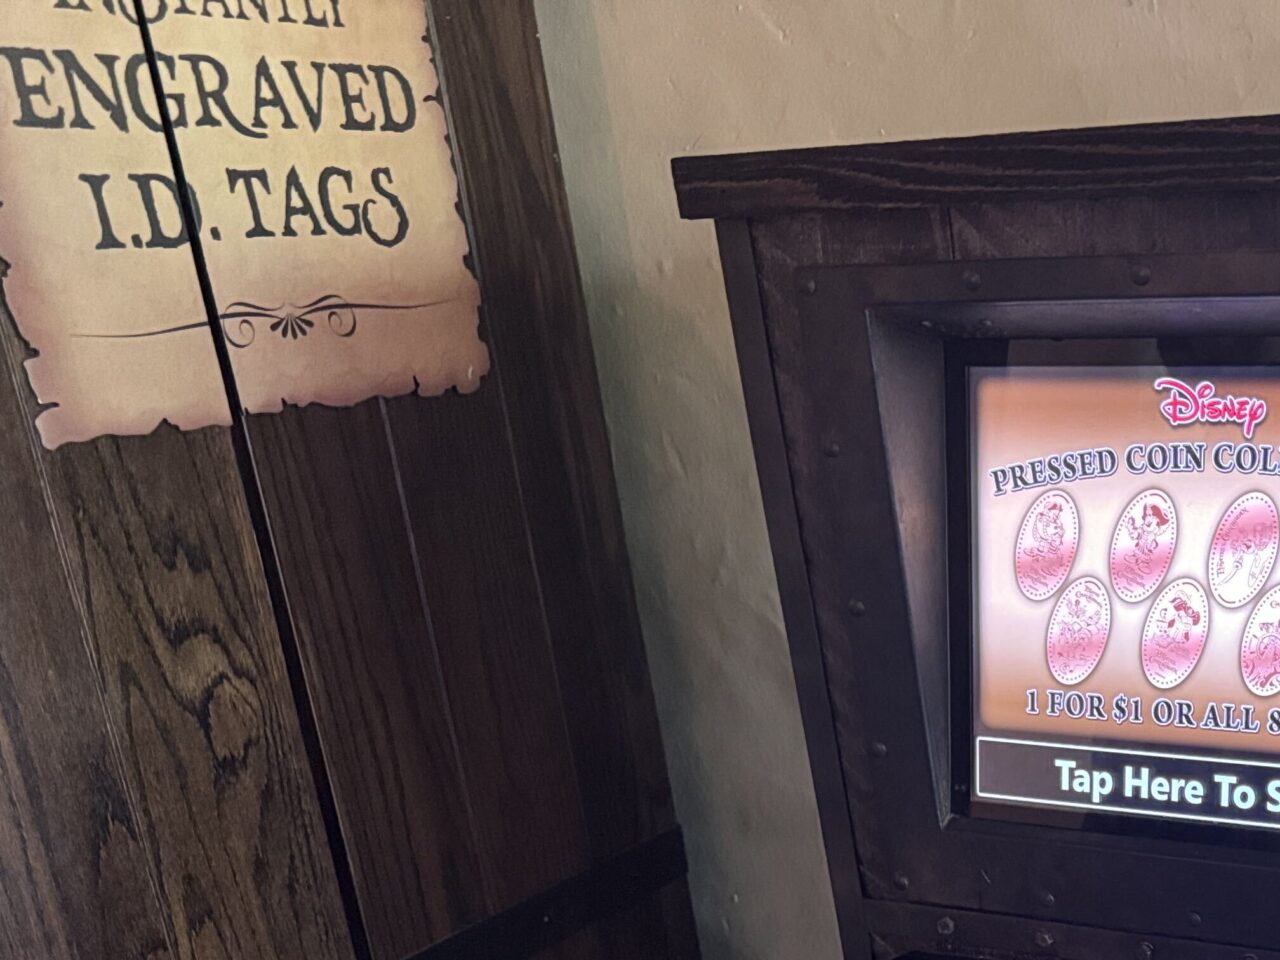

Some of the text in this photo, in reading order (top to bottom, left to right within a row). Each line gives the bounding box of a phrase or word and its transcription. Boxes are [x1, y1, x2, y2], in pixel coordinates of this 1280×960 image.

[0, 47, 417, 139] ENGRAVED
[78, 164, 410, 250] I.D. TAGS
[1153, 377, 1268, 439] Disney
[990, 448, 1118, 496] PRESSED
[1125, 442, 1206, 474] COIN
[1026, 689, 1039, 715] 1
[1047, 690, 1106, 721] FOR
[1112, 695, 1143, 724] $1
[1151, 698, 1197, 729] OR
[1201, 703, 1260, 734] ALL
[1054, 759, 1114, 802] Tap
[1123, 765, 1204, 805] Here
[1214, 774, 1256, 809] To
